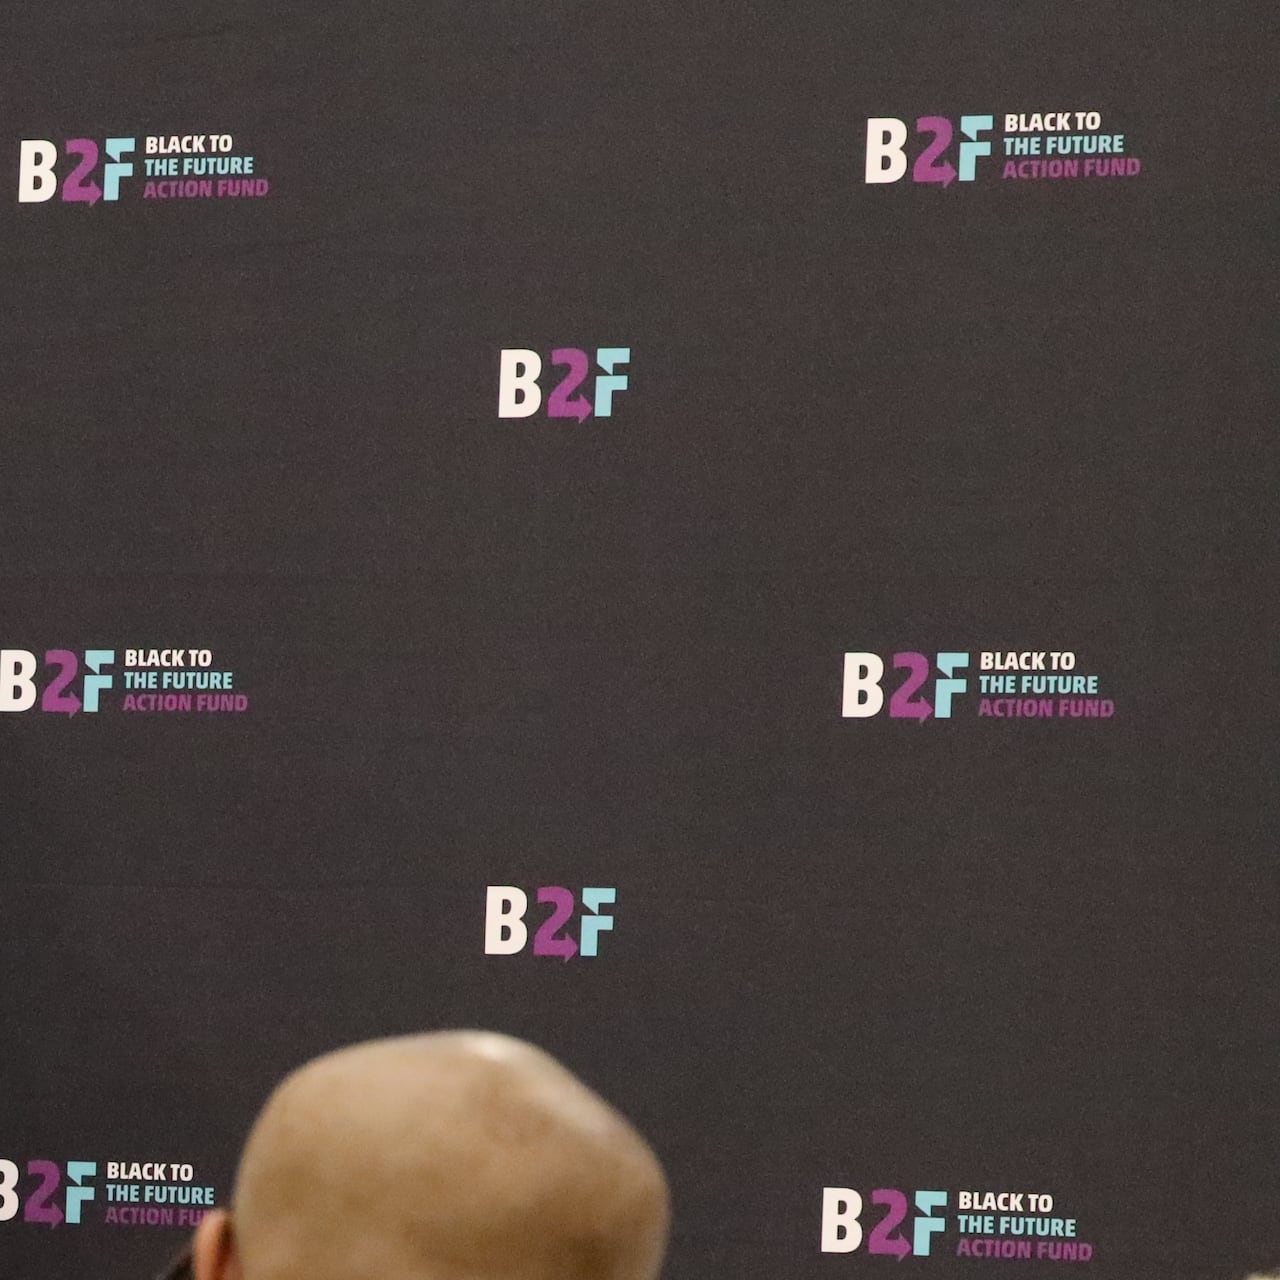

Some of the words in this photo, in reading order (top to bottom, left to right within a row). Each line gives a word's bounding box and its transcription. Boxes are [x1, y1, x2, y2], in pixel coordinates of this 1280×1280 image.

[1004, 111, 1072, 131] BLACK
[1074, 110, 1102, 129] TO
[145, 134, 206, 154] BLACK
[208, 133, 233, 152] TO
[865, 115, 994, 187] B2F
[1003, 136, 1042, 155] THE
[1045, 134, 1125, 154] FUTURE
[19, 137, 136, 206] B2F
[143, 158, 179, 176] THE
[182, 156, 254, 175] FUTURE
[1003, 159, 1079, 178] ACTION
[1084, 157, 1140, 176] FUND
[143, 180, 213, 198] ACTION
[217, 179, 269, 196] FUND
[497, 347, 631, 422] B2F
[123, 648, 186, 665] BLACK
[188, 648, 214, 665] TO
[979, 651, 1048, 670] BLACK
[1049, 651, 1077, 670] TO
[0, 649, 115, 717] B2F
[123, 671, 159, 688] THE
[162, 671, 233, 688] FUTURE
[842, 652, 970, 722] B2F
[978, 676, 1017, 693] THE
[1021, 676, 1099, 693] FUTURE
[123, 694, 192, 711] ACTION
[196, 694, 248, 711] FUND
[979, 699, 1053, 716] ACTION
[1059, 699, 1114, 716] FUND
[484, 885, 616, 962] B2F
[106, 1161, 166, 1181] BLACK
[169, 1163, 194, 1182] TO
[105, 1184, 140, 1203] THE
[144, 1185, 215, 1206] FUTURE
[958, 1190, 1024, 1212] BLACK
[1027, 1193, 1055, 1213] TO
[104, 1206, 173, 1226] ACTION
[177, 1208, 208, 1227] FU
[821, 1187, 948, 1261] B2F
[956, 1214, 996, 1234] THE
[999, 1216, 1078, 1237] FUTURE
[957, 1237, 1031, 1258] ACTION
[1037, 1240, 1093, 1261] FUND
